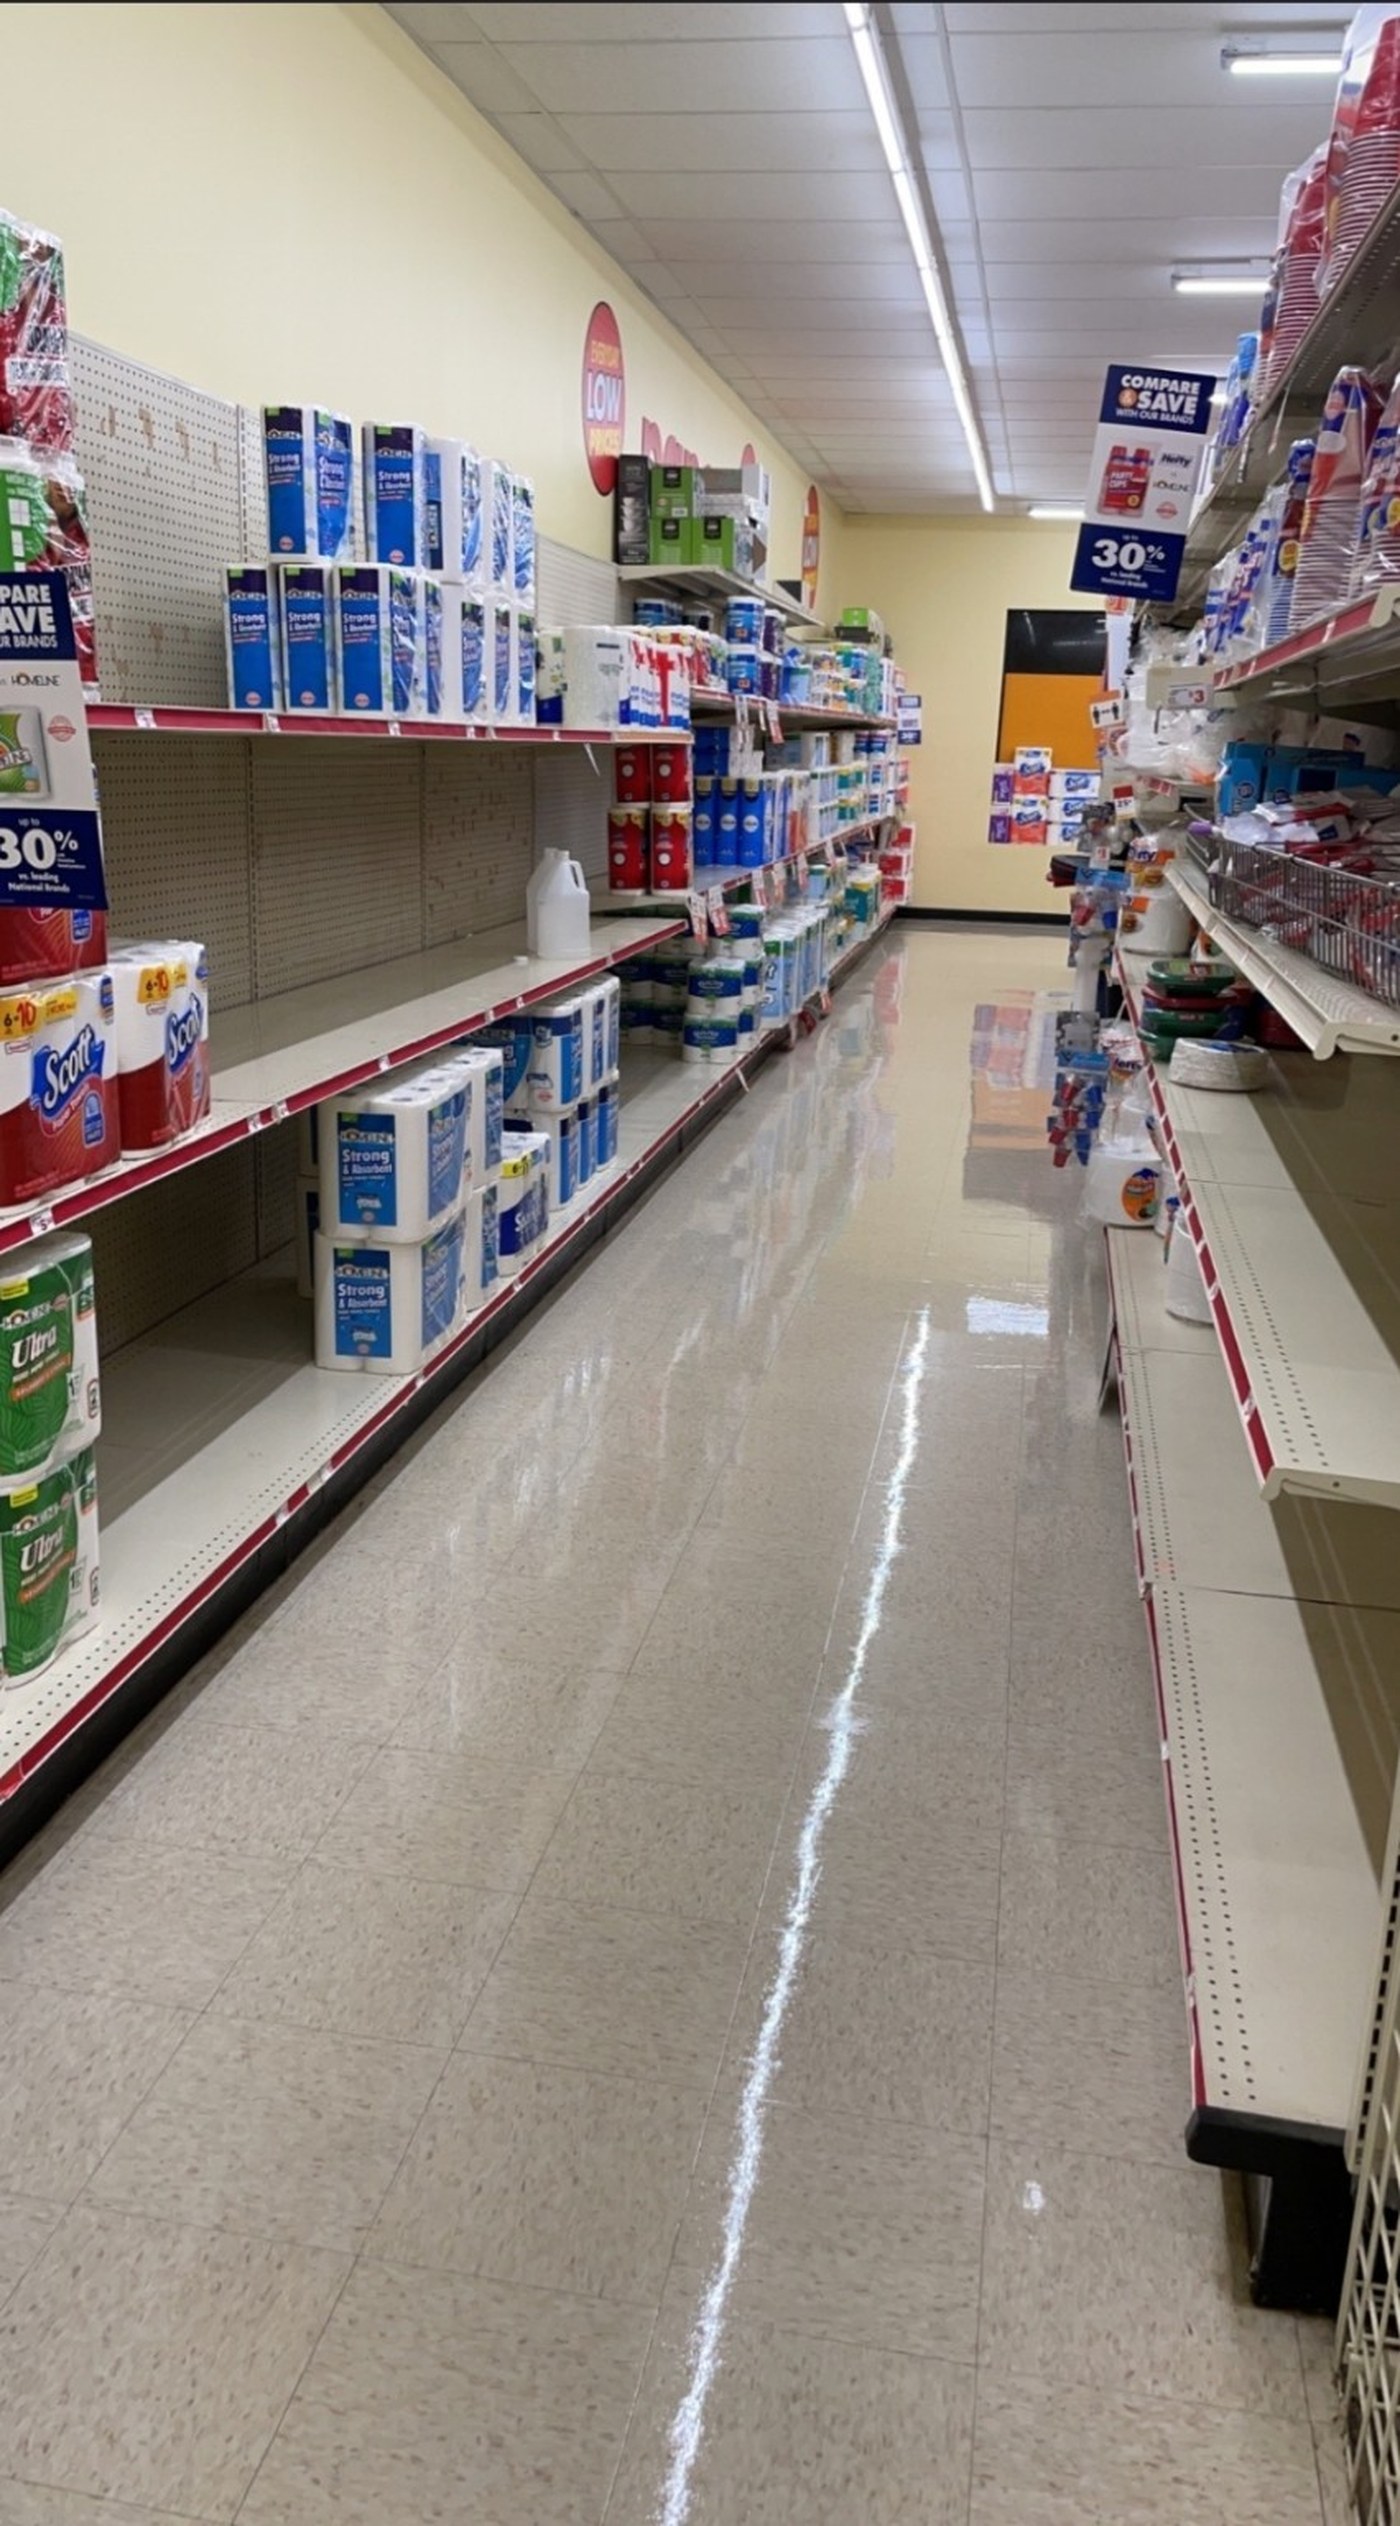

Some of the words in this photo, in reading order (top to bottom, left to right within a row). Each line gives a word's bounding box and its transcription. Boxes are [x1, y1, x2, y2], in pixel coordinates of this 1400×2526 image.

[1121, 375, 1200, 396] COMPARE
[587, 372, 622, 423] LOW
[1138, 391, 1198, 415] SAVE
[1116, 408, 1138, 417] WITH
[1140, 410, 1158, 420] OUR
[1160, 414, 1194, 424] BRANDS
[379, 470, 410, 482] Strong
[1092, 538, 1166, 571] 30%
[232, 612, 265, 625] Strong
[289, 612, 322, 625] Strong
[344, 612, 377, 625] Strong
[13, 635, 58, 649] BRANDS
[18, 818, 29, 827] up
[31, 817, 40, 826] to
[0, 827, 79, 870] 30%
[31, 871, 59, 883] leading
[8, 882, 43, 892] National
[45, 884, 70, 893] Brands
[168, 997, 200, 1066] Scott
[44, 1026, 91, 1109] Scott
[342, 1149, 390, 1165] Strong
[338, 1283, 385, 1299] Strong
[12, 1325, 57, 1369] Ultra
[21, 1526, 64, 1572] Ultra
